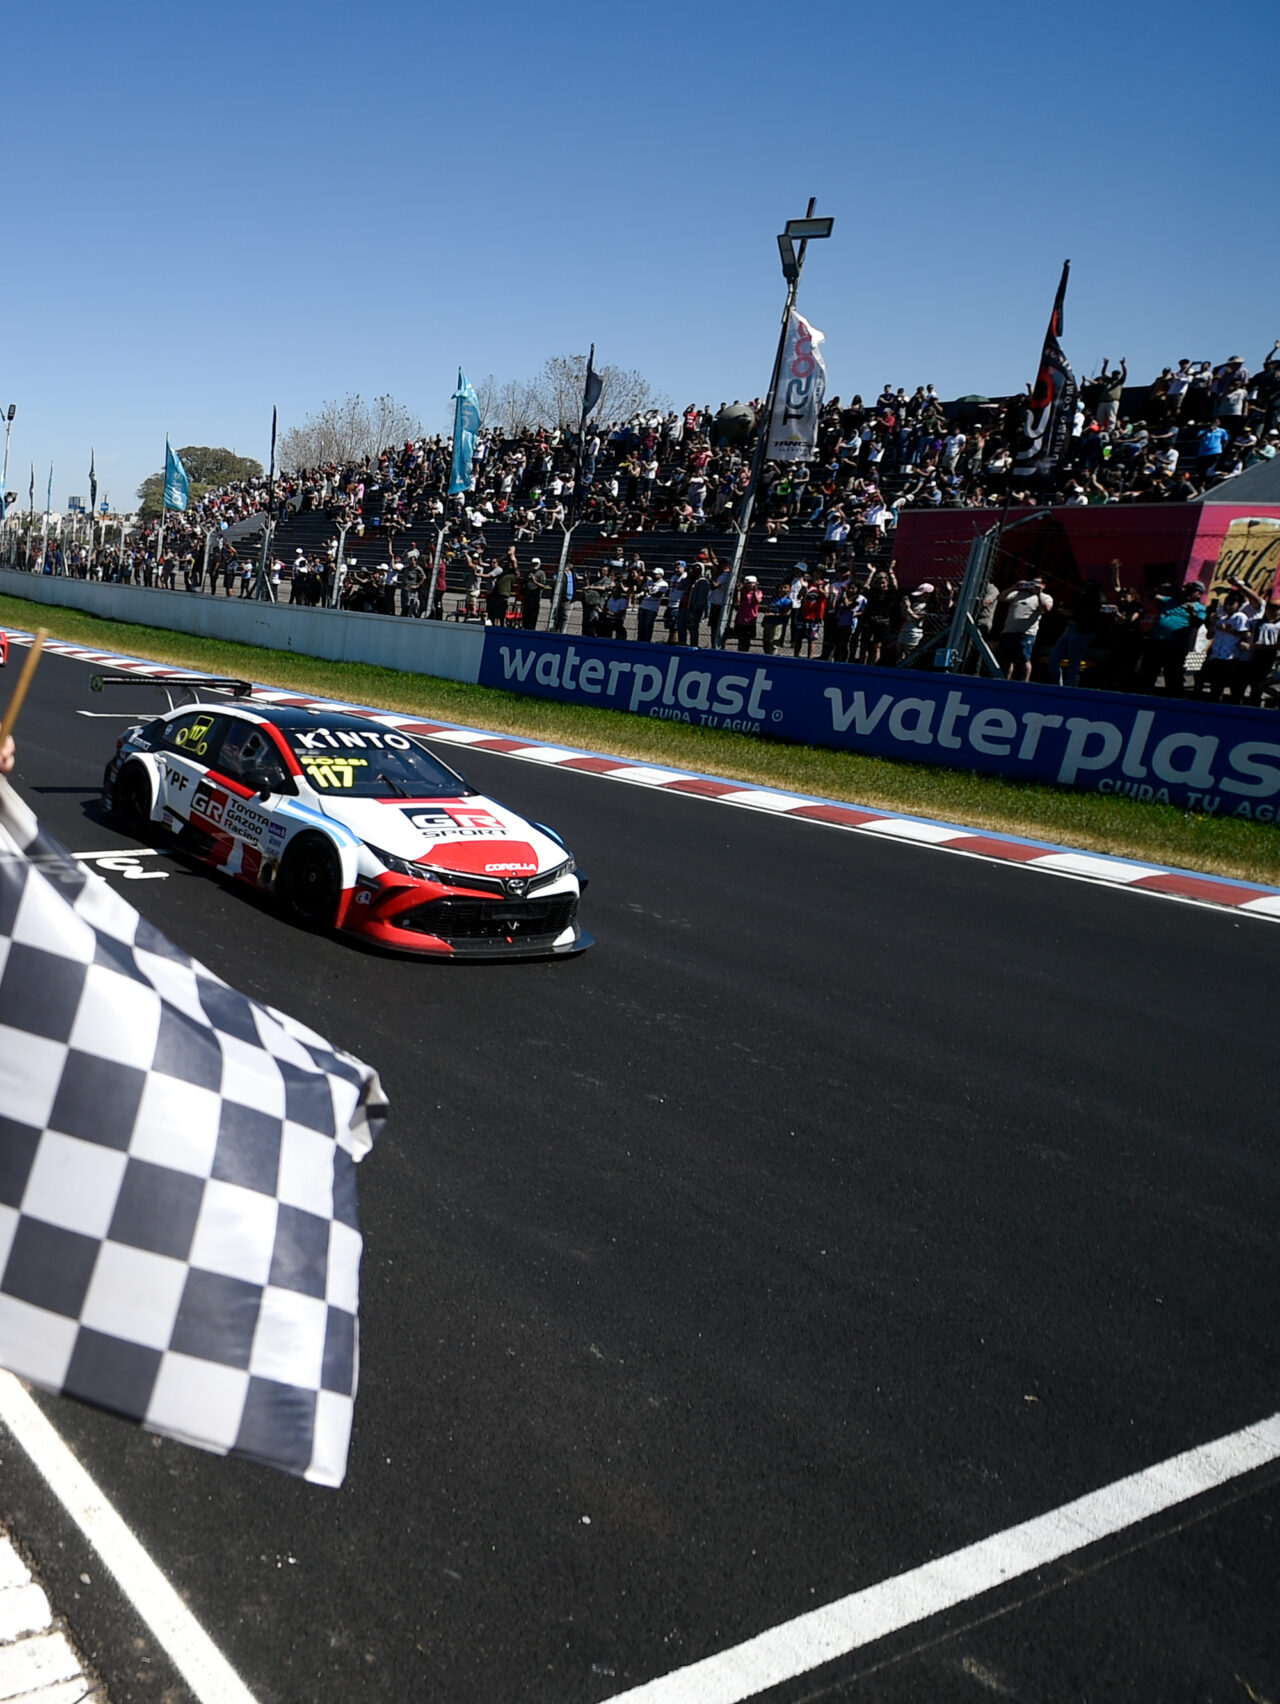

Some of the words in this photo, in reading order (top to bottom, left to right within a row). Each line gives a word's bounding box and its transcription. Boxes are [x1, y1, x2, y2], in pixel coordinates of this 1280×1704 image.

[499, 646, 772, 711] waterplast
[189, 725, 208, 741] 117
[650, 706, 691, 724] CUIDA
[700, 714, 718, 728] TU
[722, 717, 761, 735] AGUA
[300, 757, 368, 766] ROSSI
[165, 764, 189, 791] YPF
[306, 765, 353, 788] 117
[191, 793, 224, 823] GR
[231, 798, 270, 827] TOYOTA
[1097, 778, 1169, 804] CUIDA
[1187, 792, 1220, 812] TU
[1233, 801, 1280, 826] AG
[224, 819, 259, 847] Racing
[226, 809, 263, 835] GAZOO
[411, 814, 506, 828] GR
[422, 829, 509, 839] SPORT
[484, 863, 537, 872] COROLLA
